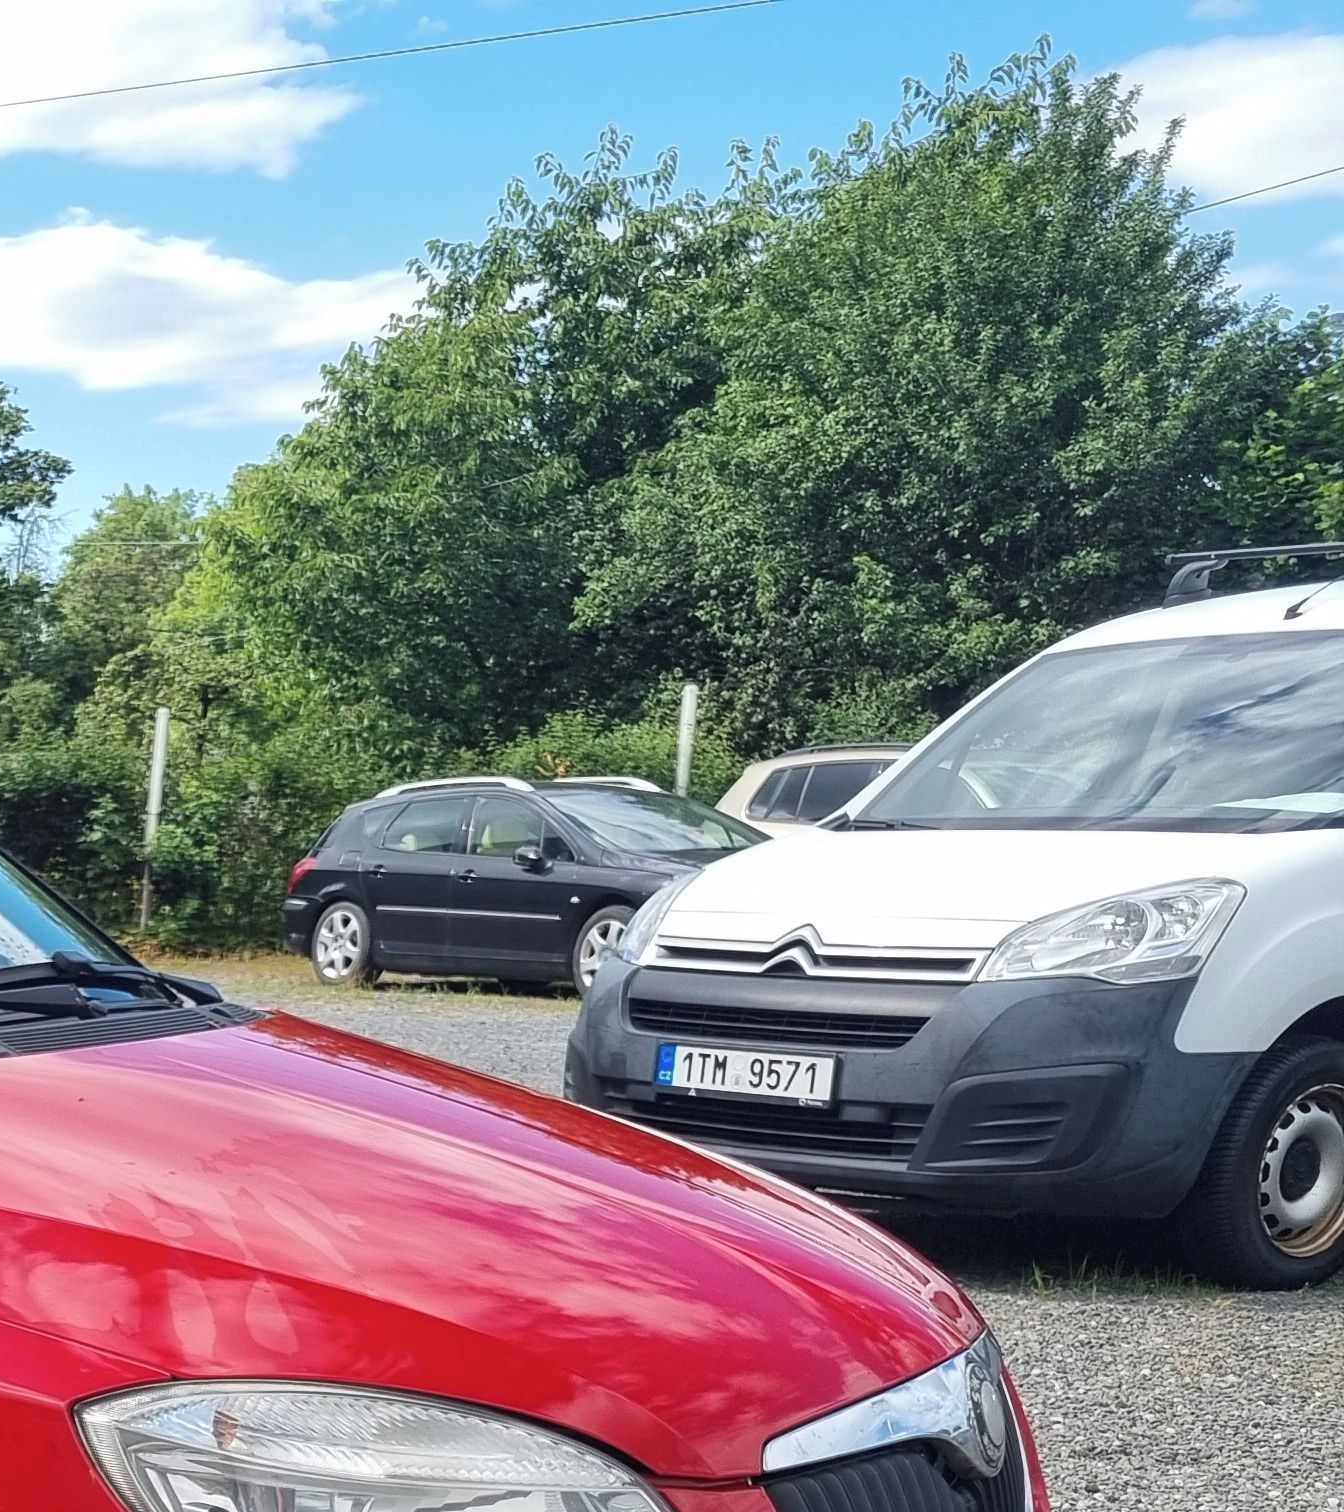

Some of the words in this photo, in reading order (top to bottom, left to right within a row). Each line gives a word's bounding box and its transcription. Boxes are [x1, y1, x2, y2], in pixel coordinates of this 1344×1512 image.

[658, 1070, 672, 1081] CZ
[683, 1051, 728, 1086] 1TM
[748, 1058, 818, 1095] 9571
